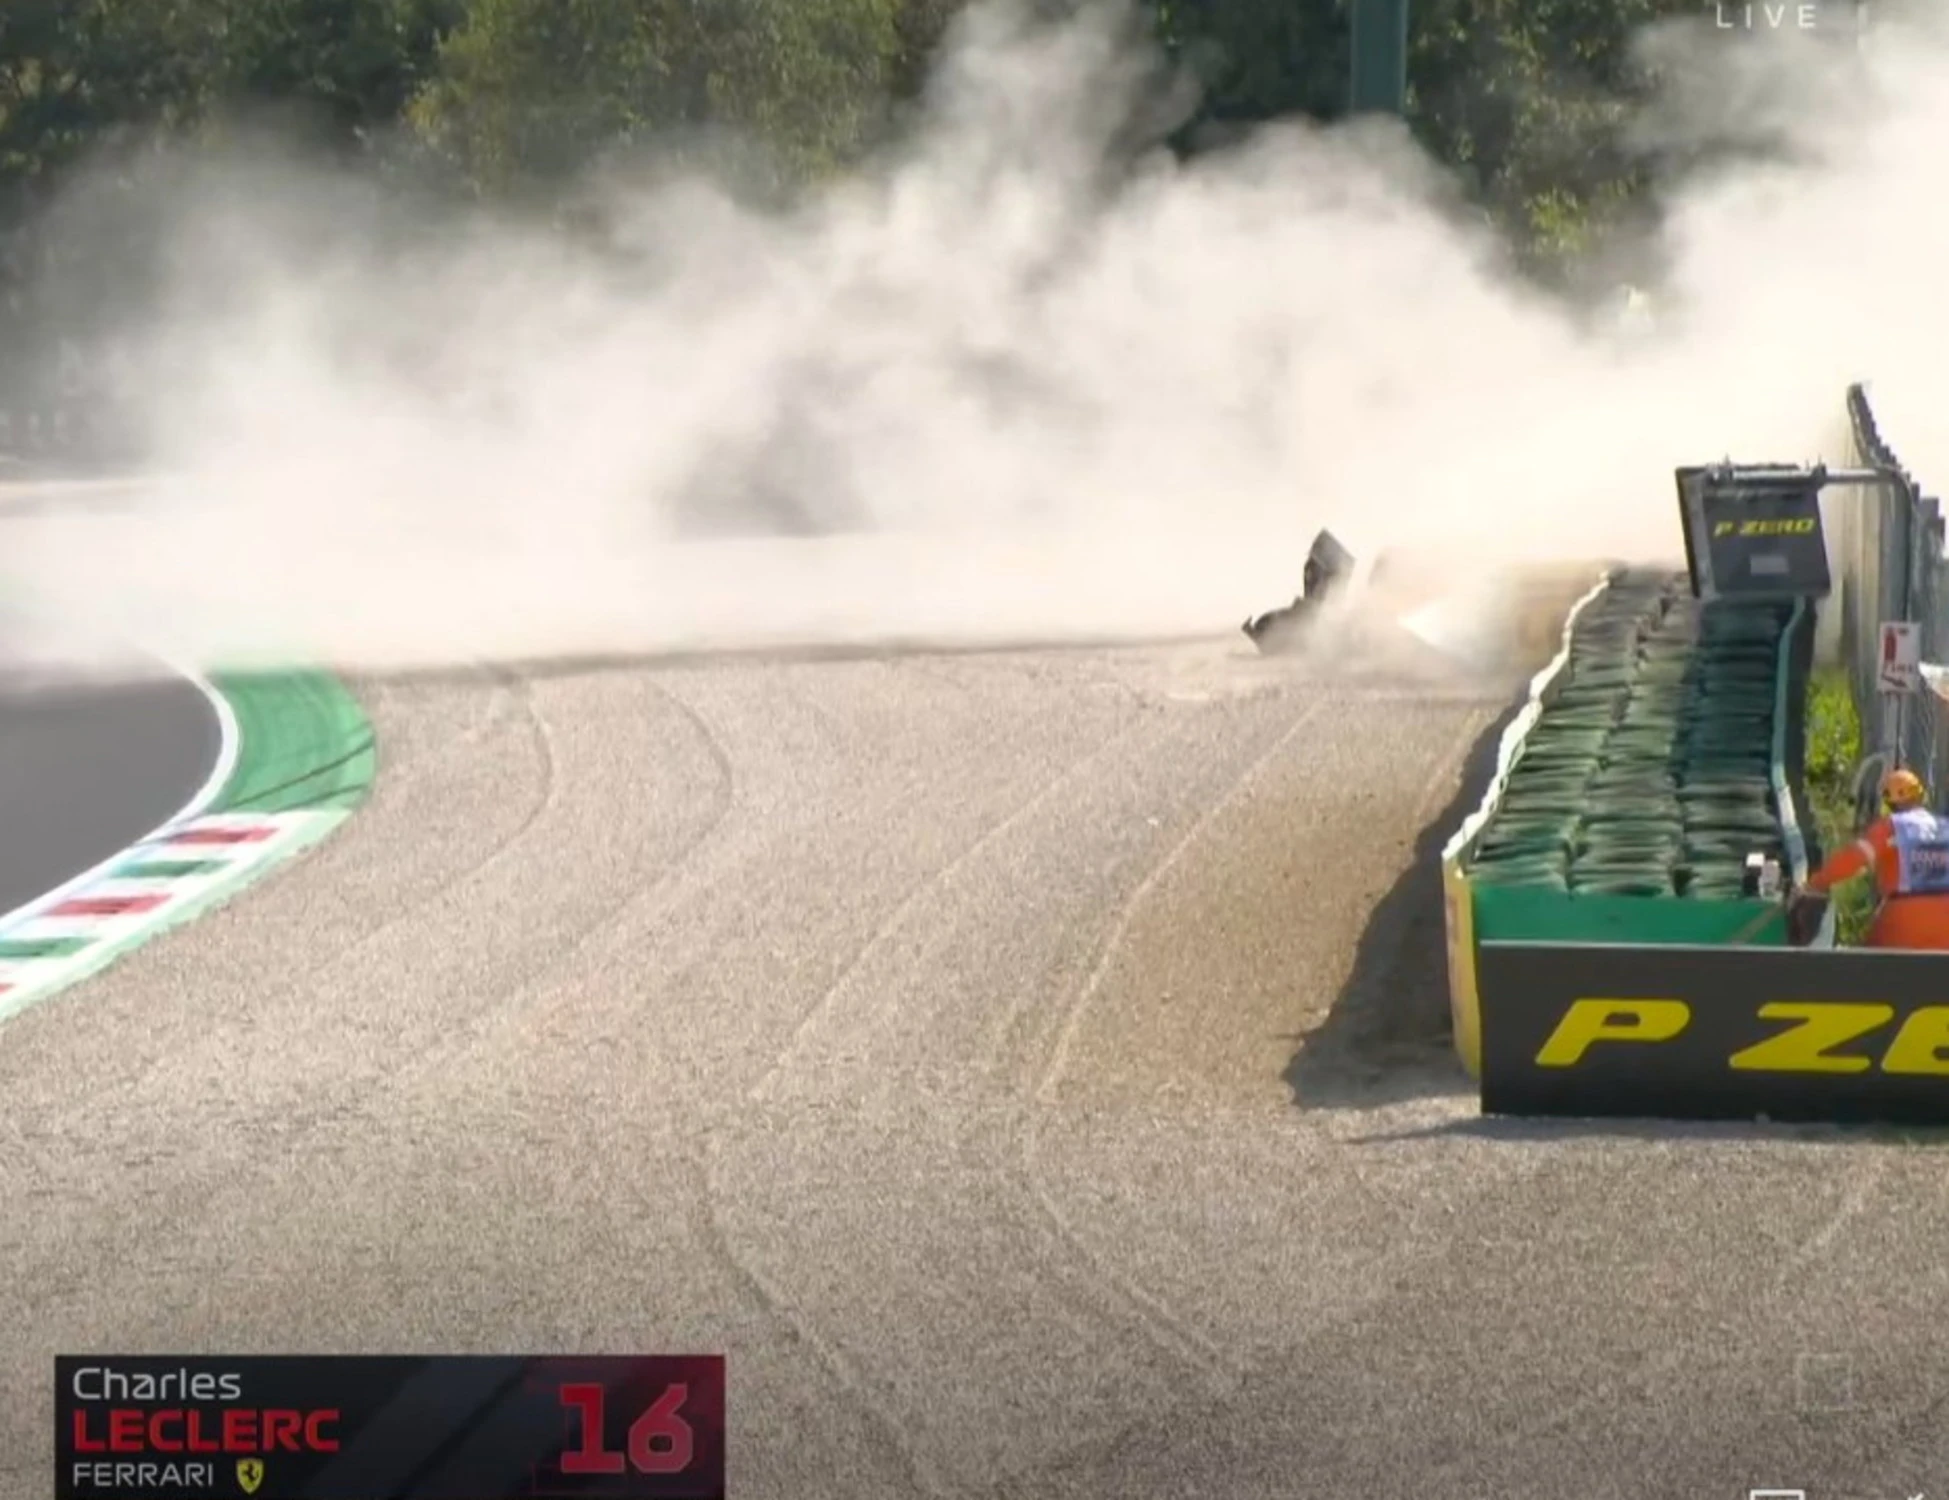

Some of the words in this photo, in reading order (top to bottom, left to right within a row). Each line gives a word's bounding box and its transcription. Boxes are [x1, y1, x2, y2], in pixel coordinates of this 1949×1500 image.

[1714, 521, 1734, 537] P
[1740, 517, 1815, 535] ZERO
[1535, 998, 1692, 1068] P
